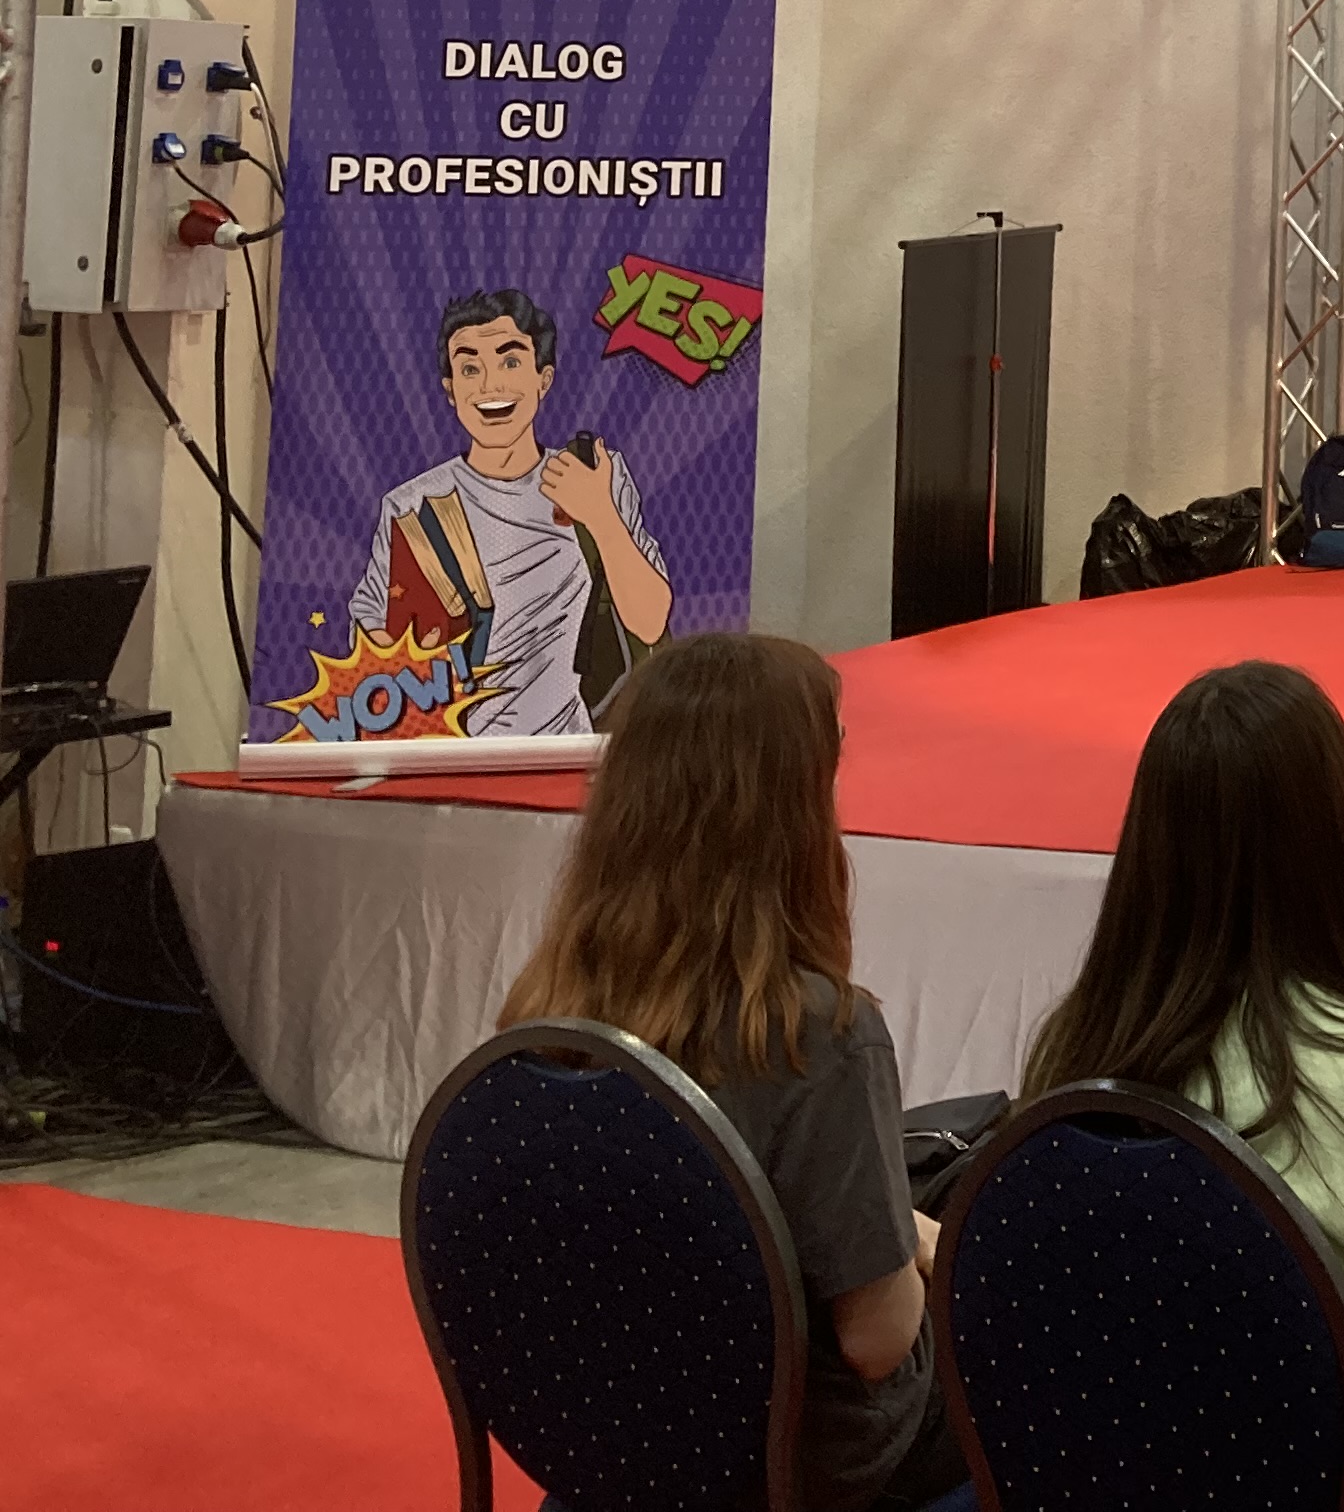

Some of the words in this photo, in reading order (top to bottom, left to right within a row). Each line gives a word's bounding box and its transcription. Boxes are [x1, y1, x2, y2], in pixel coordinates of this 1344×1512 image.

[444, 42, 624, 81] DIALOG
[500, 102, 566, 139] CU
[328, 155, 723, 207] PROFESIONIȘTII
[601, 265, 752, 372] YES!
[299, 642, 476, 742] WOW!
